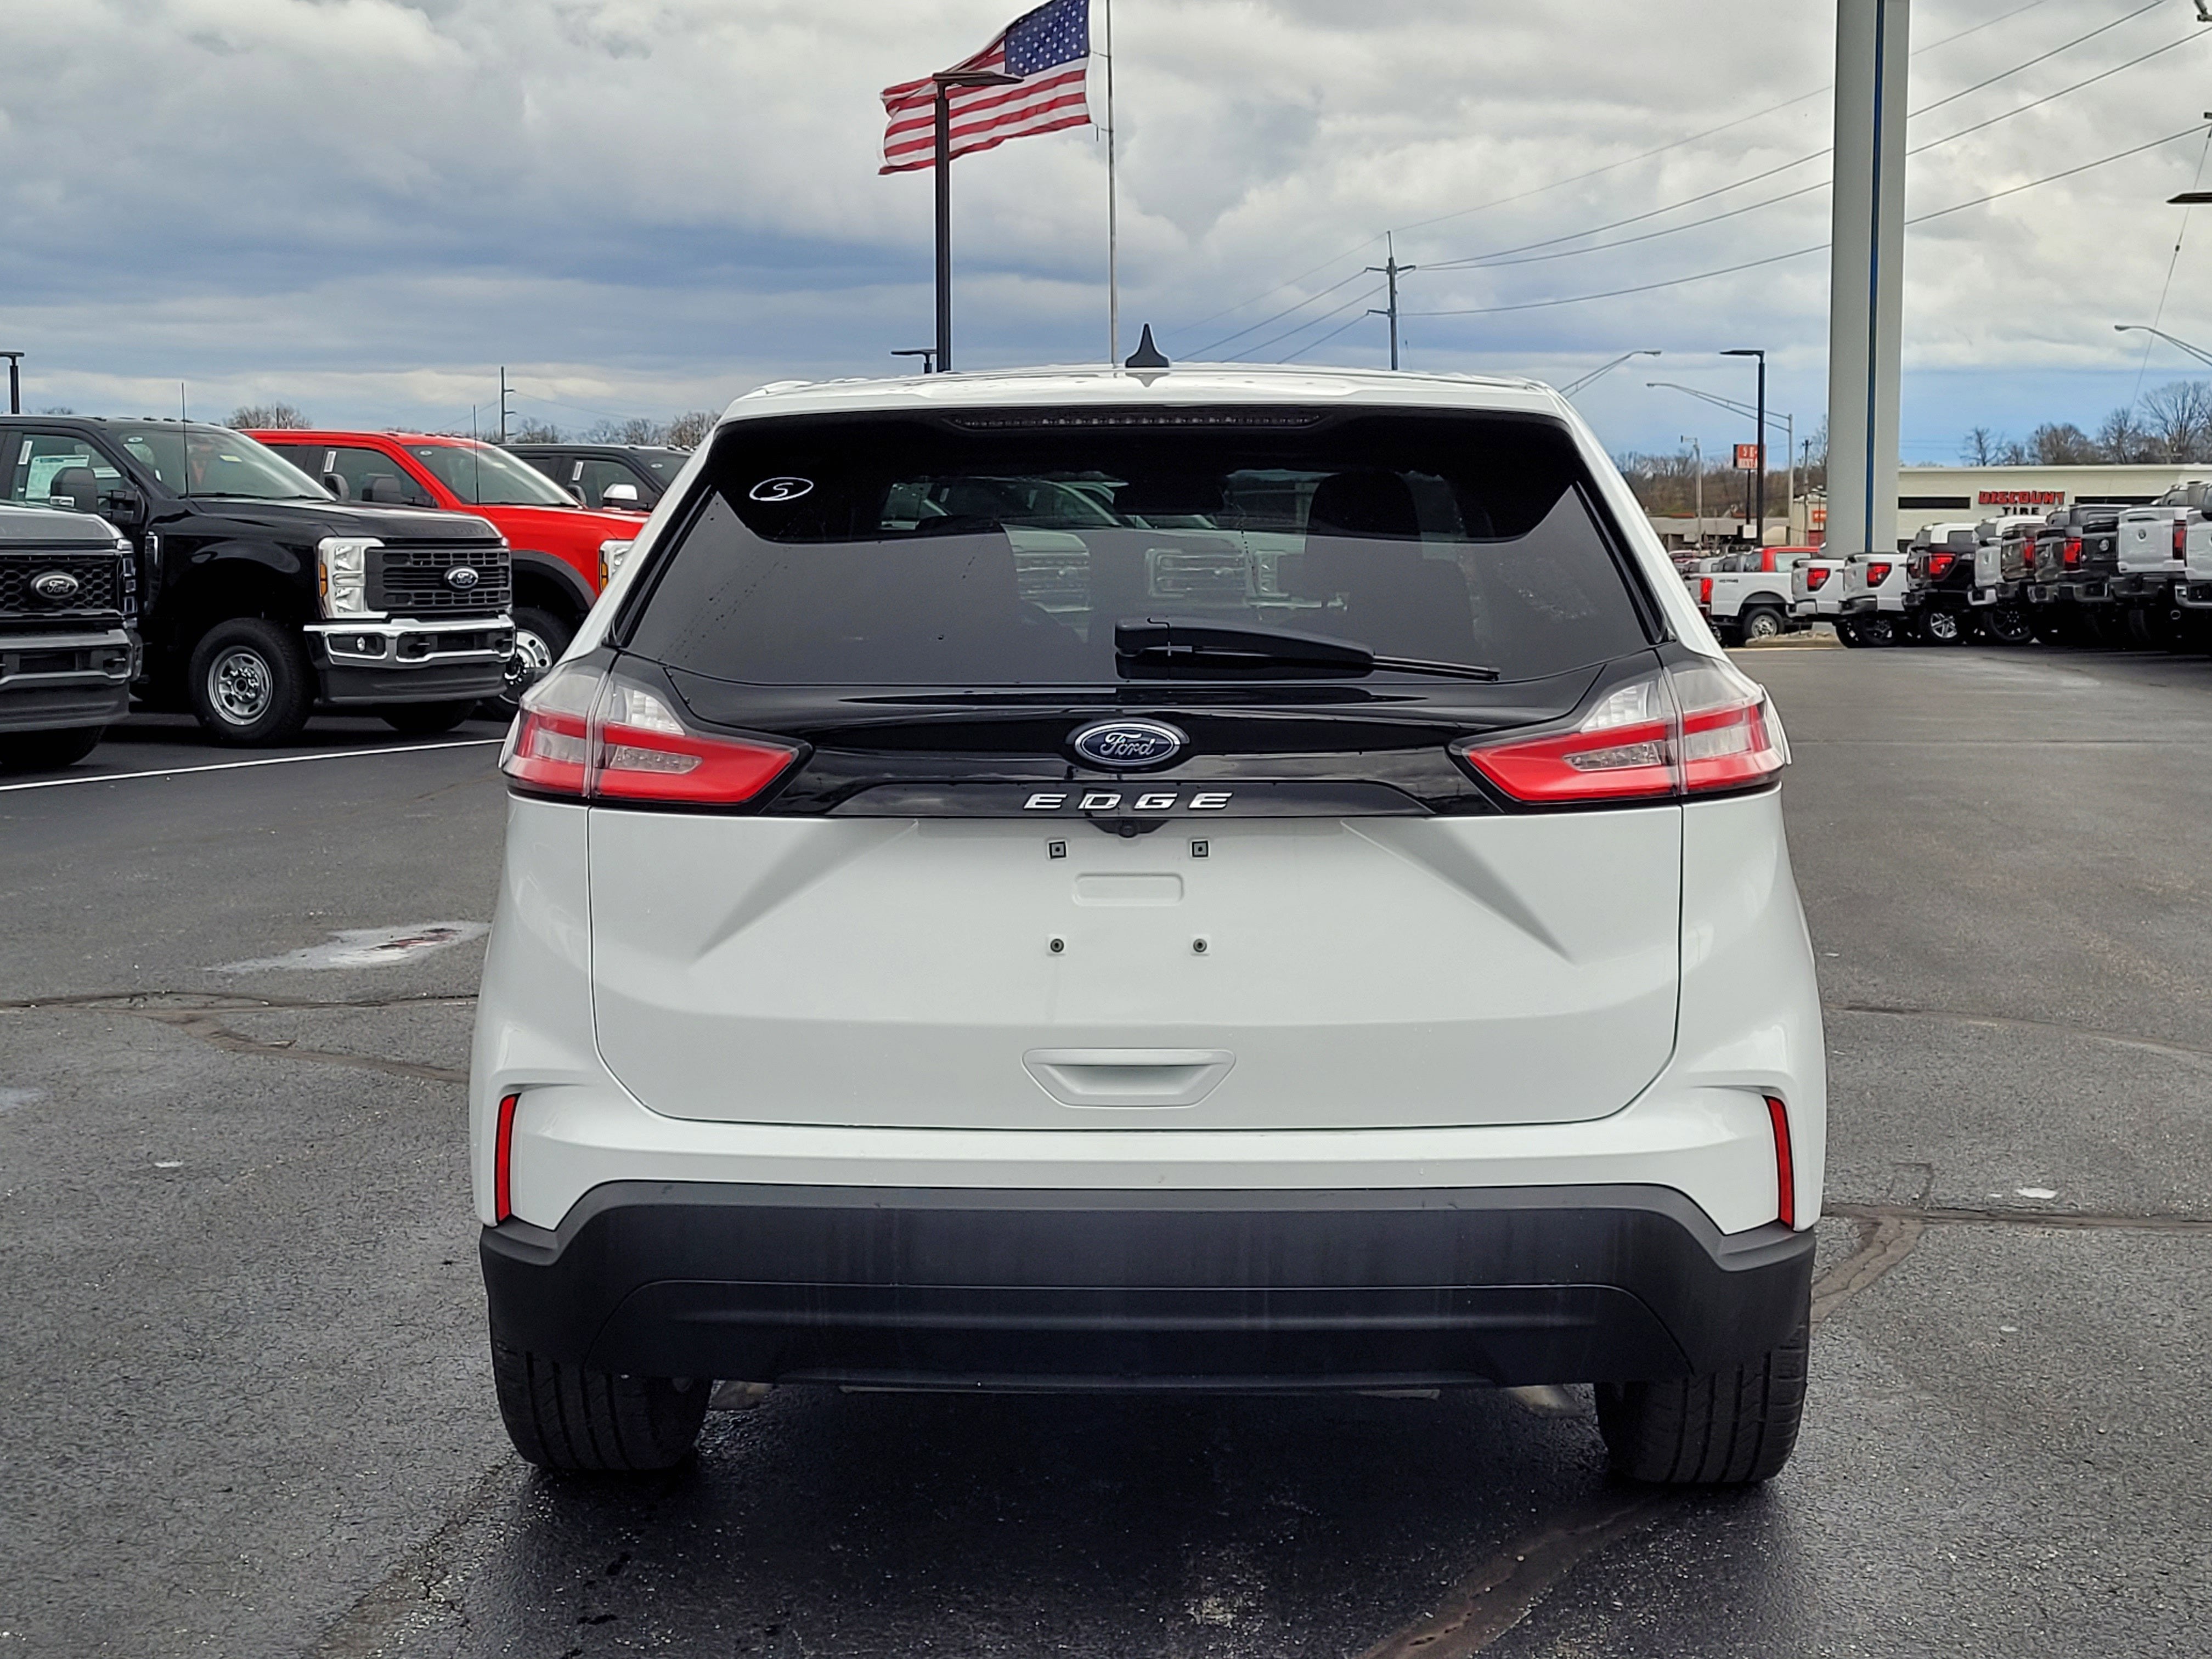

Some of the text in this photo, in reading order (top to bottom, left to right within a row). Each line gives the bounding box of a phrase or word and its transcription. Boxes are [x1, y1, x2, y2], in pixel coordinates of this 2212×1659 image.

[1978, 490, 2065, 505] DISCOUNT
[2002, 507, 2039, 515] TIRE
[47, 580, 70, 593] Ford
[1100, 732, 1155, 756] Ford
[1023, 792, 1233, 810] EDGE
